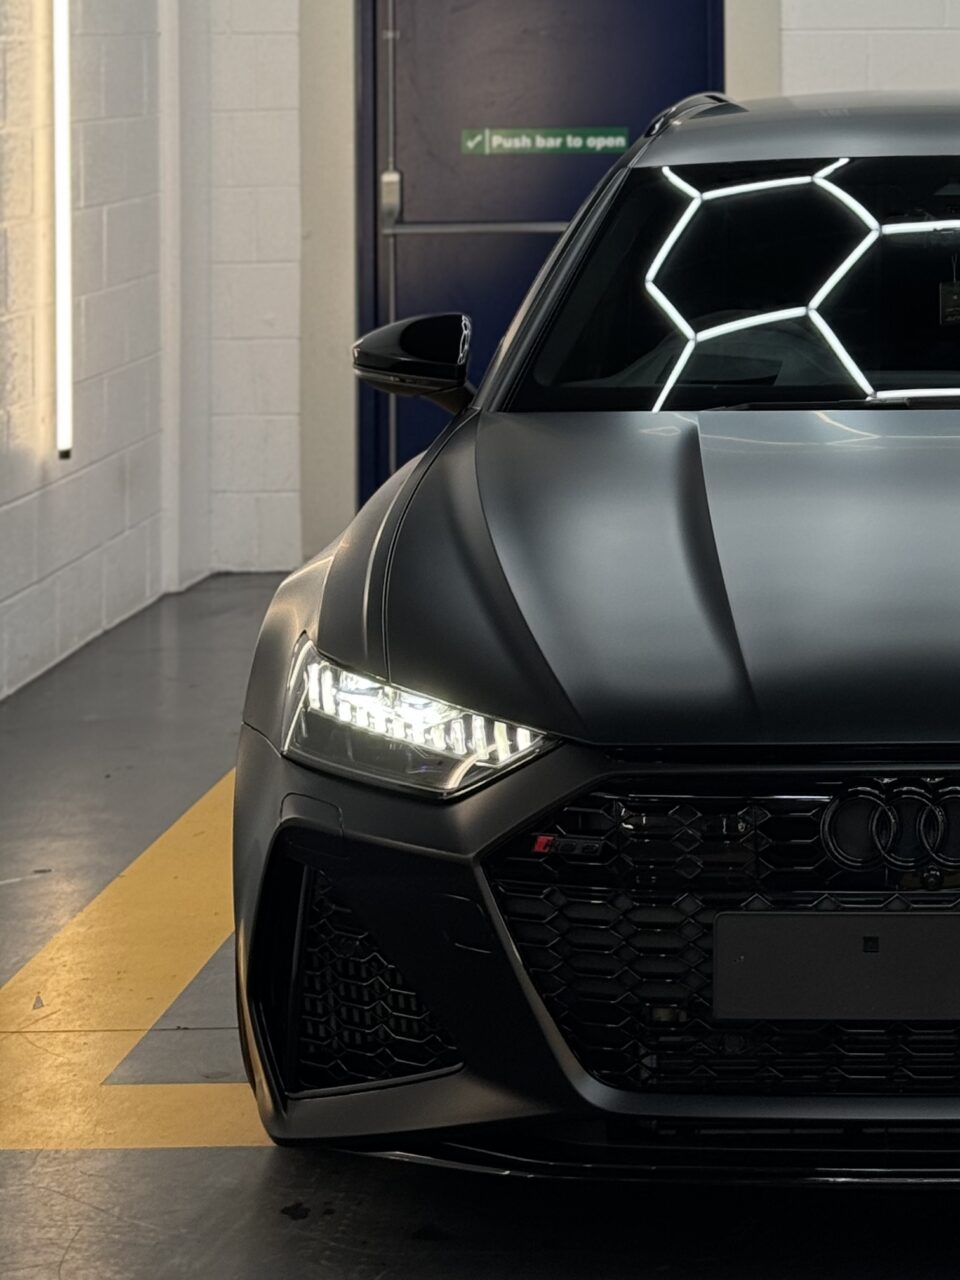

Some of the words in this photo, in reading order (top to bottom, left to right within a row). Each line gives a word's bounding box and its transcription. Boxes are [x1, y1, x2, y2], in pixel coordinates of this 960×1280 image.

[491, 135, 532, 148] Push
[535, 135, 562, 148] bar
[566, 135, 583, 148] to
[586, 136, 626, 151] open
